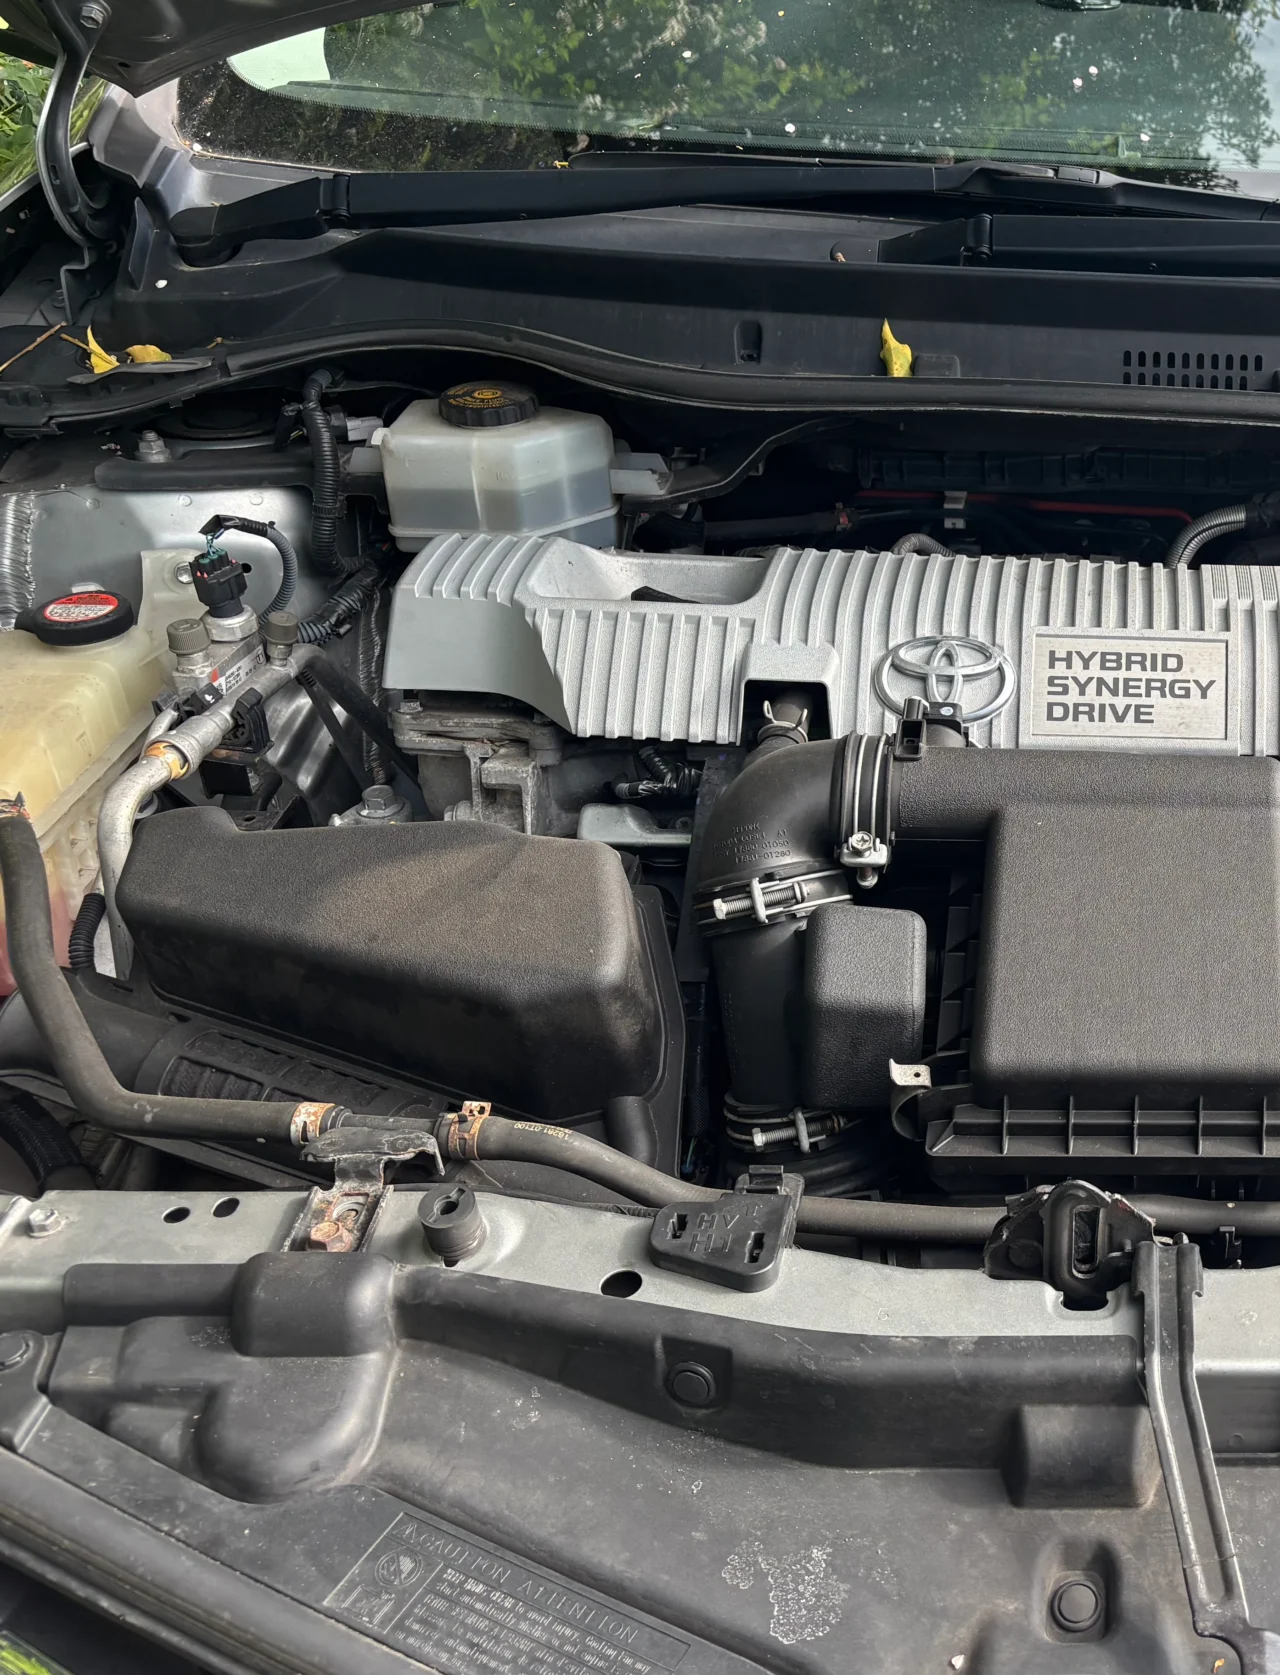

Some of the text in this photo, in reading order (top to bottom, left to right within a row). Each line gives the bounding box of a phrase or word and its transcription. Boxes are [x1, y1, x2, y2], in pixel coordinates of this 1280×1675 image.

[1048, 650, 1184, 673] HYBRID
[1047, 676, 1217, 700] SYNERGY
[1046, 702, 1155, 724] DRIVE
[697, 1212, 740, 1230] HV
[414, 1530, 641, 1643] CAUTION ATTENTION
[432, 1579, 461, 1598] start
[561, 1639, 582, 1655] not
[524, 1606, 554, 1626] avoid
